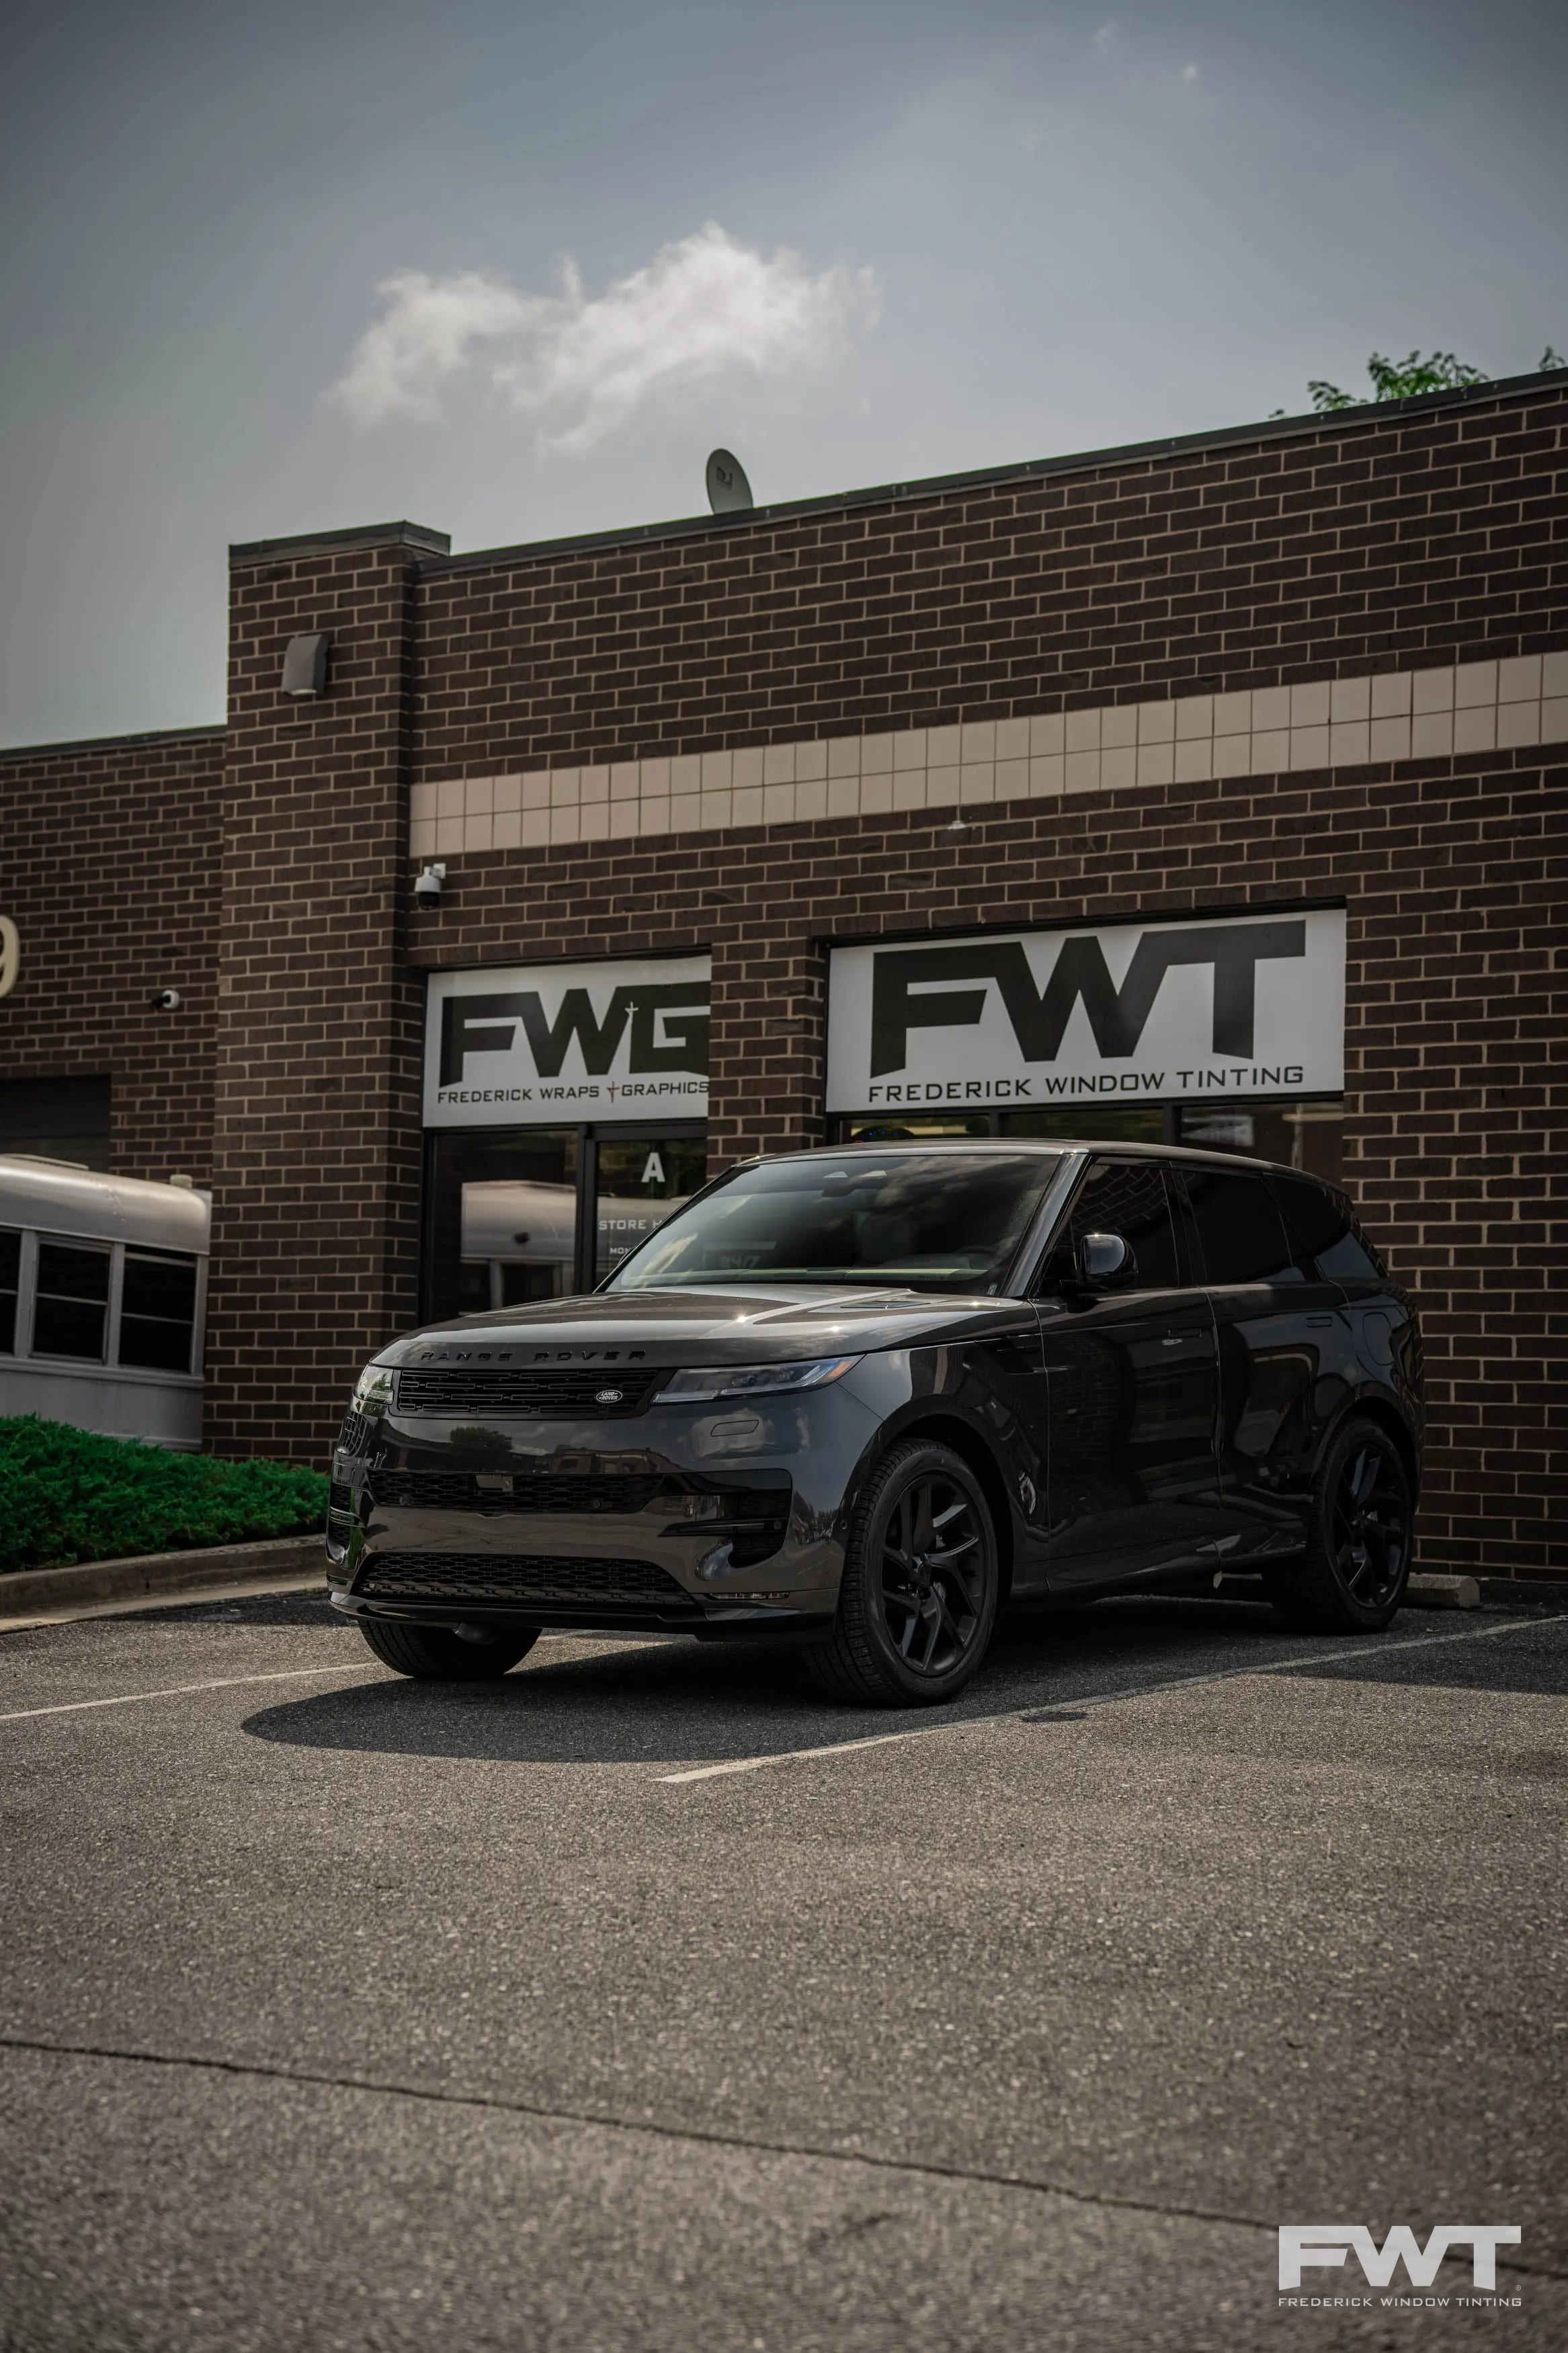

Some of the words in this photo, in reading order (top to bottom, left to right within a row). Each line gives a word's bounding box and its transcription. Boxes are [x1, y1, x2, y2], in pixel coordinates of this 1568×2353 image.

[870, 920, 1305, 1078] FWT
[440, 981, 710, 1088] FWG
[438, 1088, 532, 1104] FREDERICK
[540, 1086, 600, 1099] WRAPS
[621, 1081, 709, 1096] GRAPHICS
[868, 1078, 1031, 1103] FREDERICK
[1045, 1072, 1165, 1094] WINDOW
[1178, 1066, 1304, 1088] TINTING
[641, 1152, 665, 1183] A
[599, 1220, 647, 1230] STORE
[419, 1351, 513, 1361] RANGE
[533, 1350, 647, 1361] ROVER
